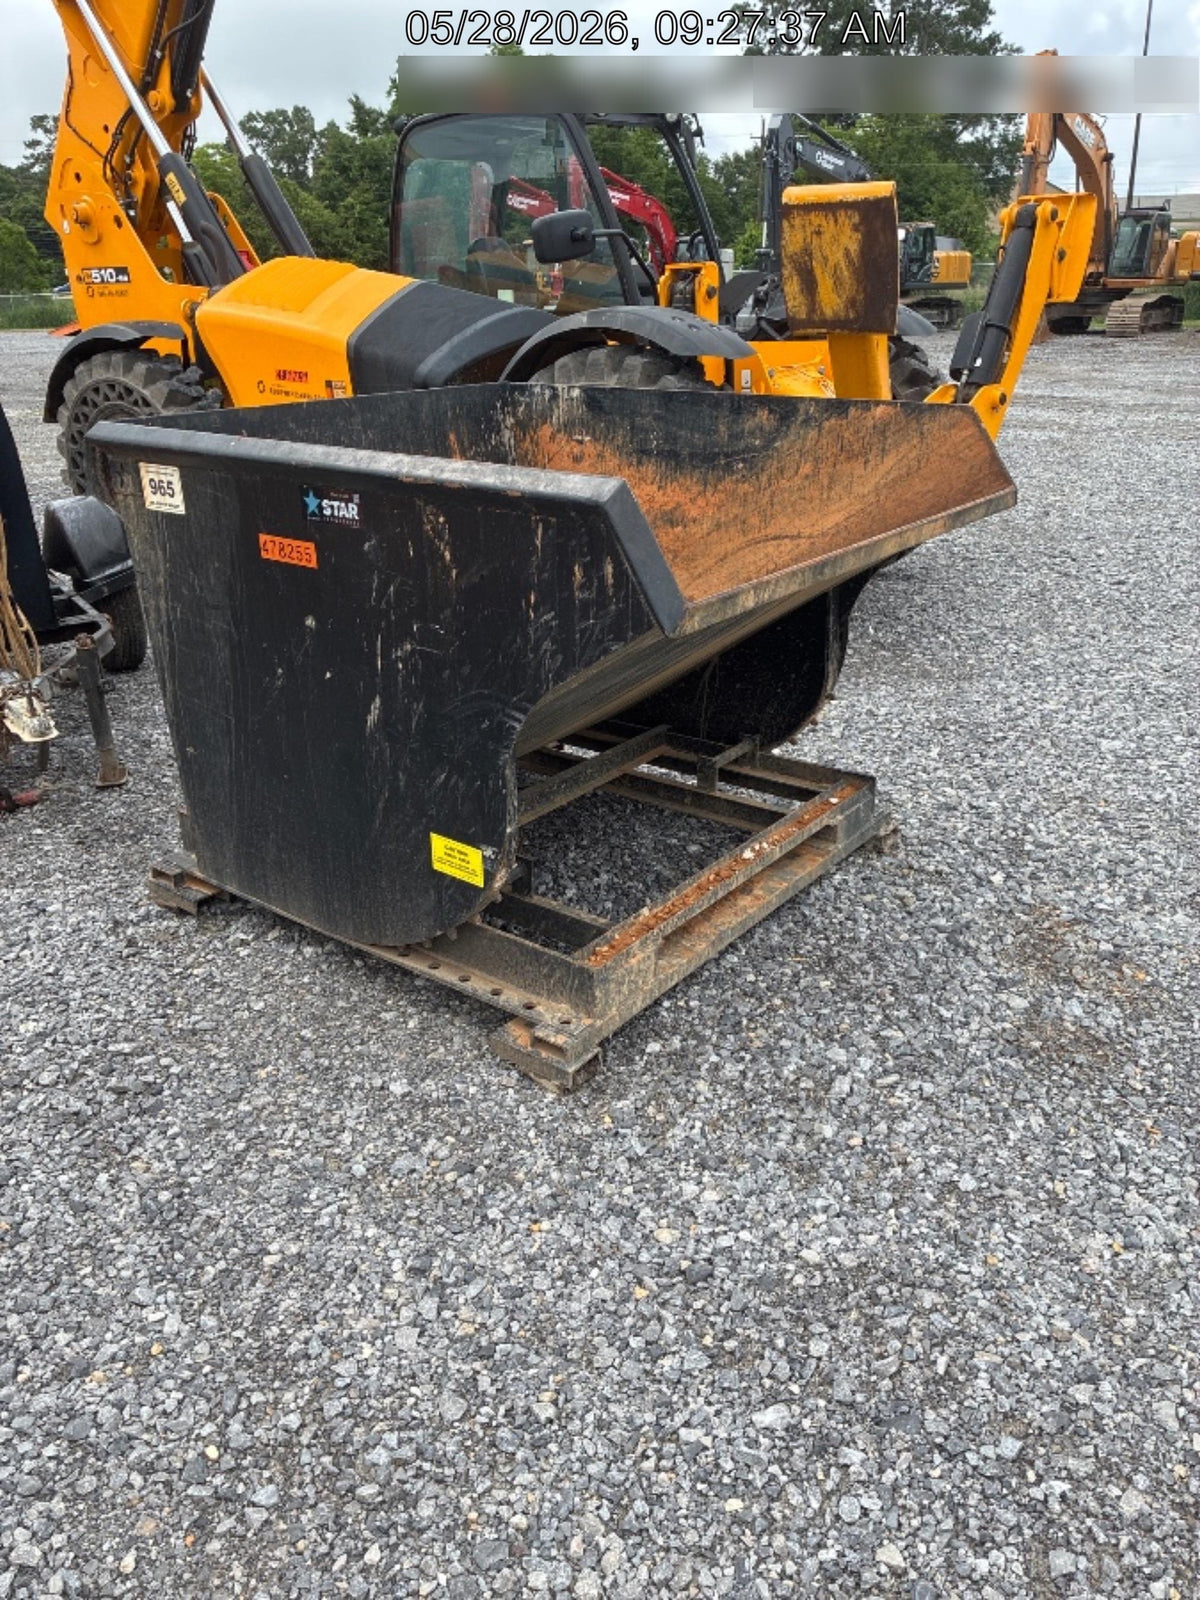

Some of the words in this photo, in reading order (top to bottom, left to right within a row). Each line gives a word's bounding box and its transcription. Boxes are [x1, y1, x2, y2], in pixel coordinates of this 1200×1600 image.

[149, 478, 175, 498] 965
[321, 499, 359, 520] STAR
[262, 539, 312, 564] 478255
